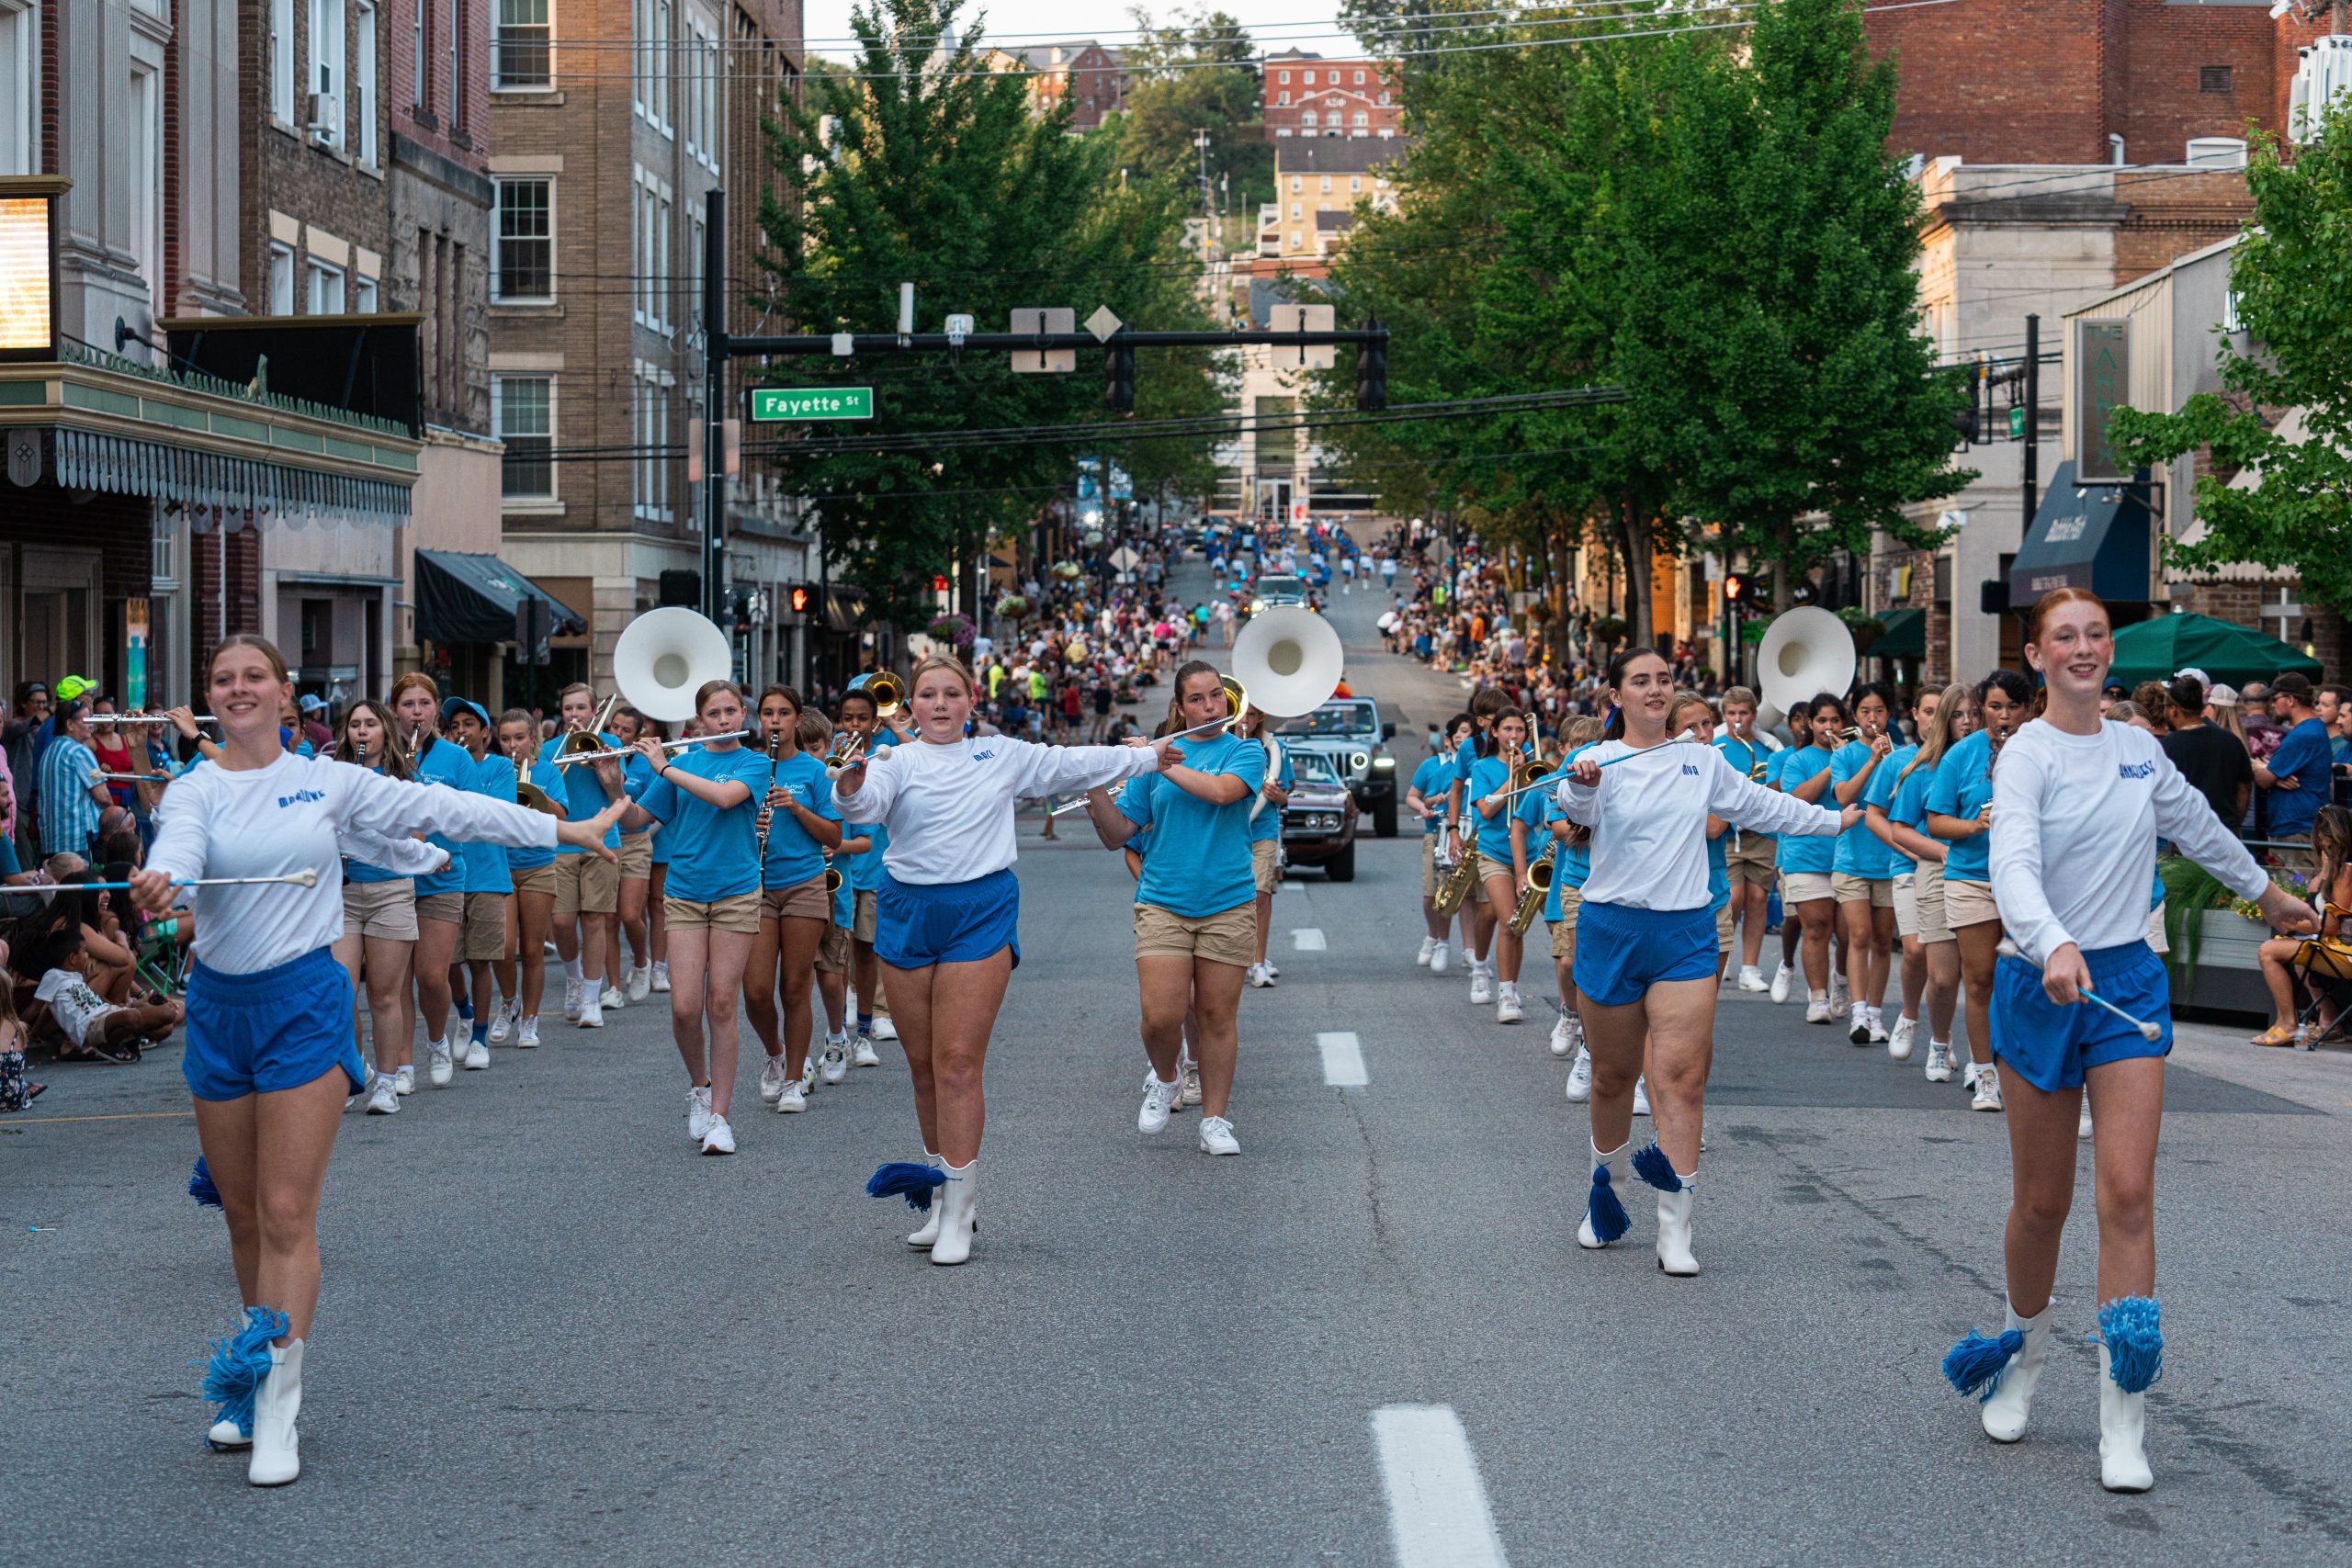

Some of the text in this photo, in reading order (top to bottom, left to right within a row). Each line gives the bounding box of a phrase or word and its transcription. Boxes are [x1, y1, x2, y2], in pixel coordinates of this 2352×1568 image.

[2087, 325, 2122, 341] THE
[765, 396, 859, 415] Fayette St
